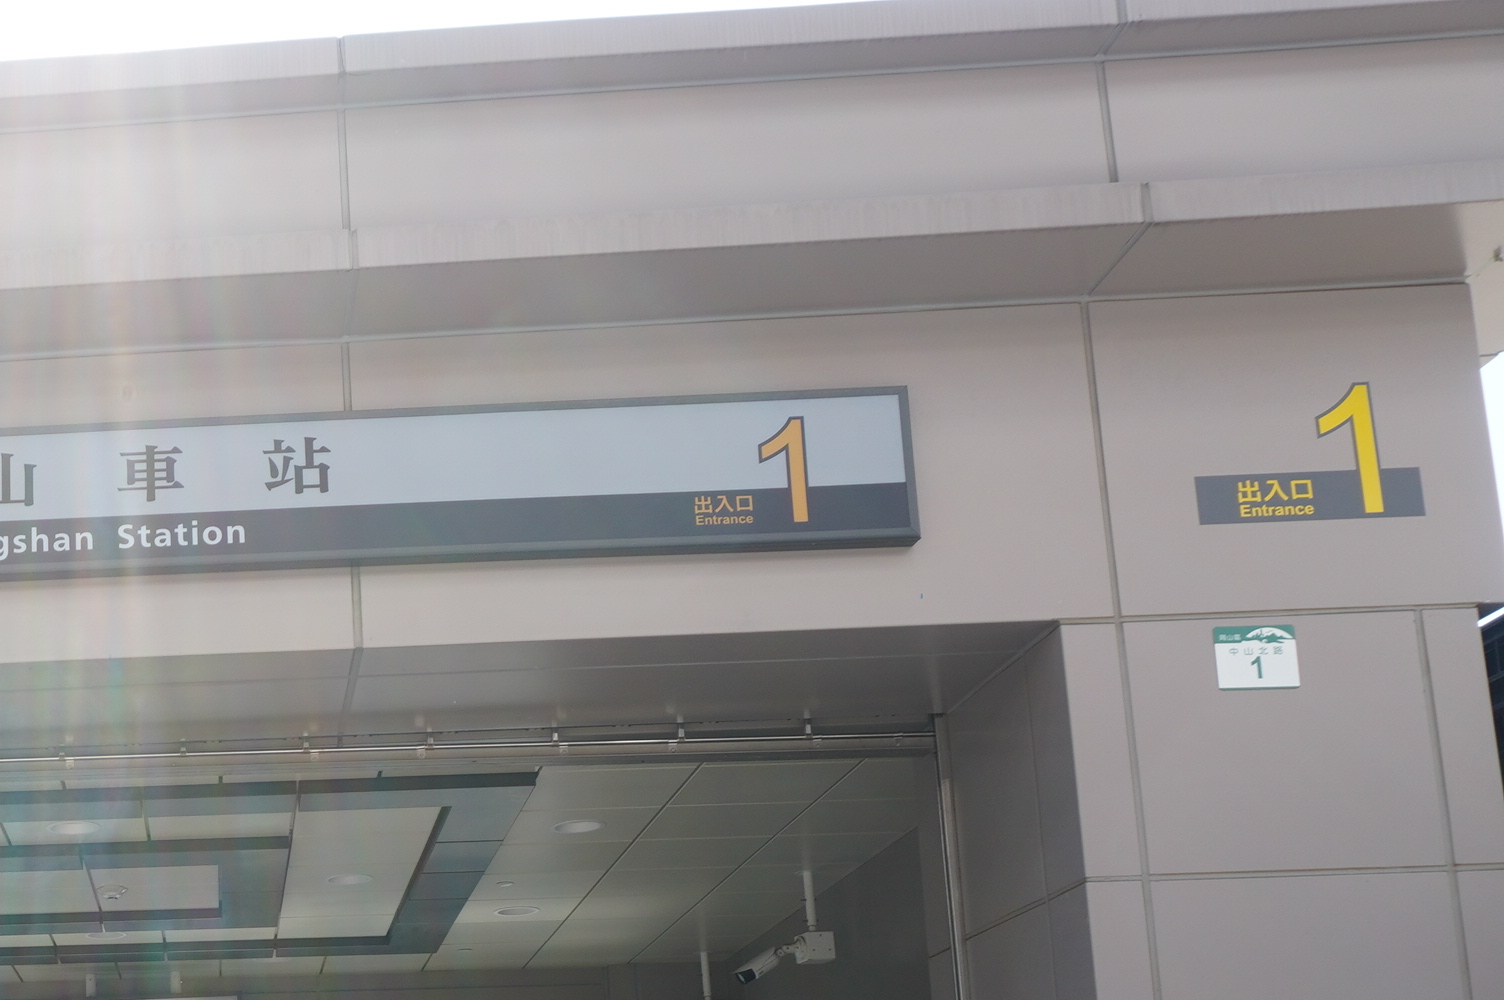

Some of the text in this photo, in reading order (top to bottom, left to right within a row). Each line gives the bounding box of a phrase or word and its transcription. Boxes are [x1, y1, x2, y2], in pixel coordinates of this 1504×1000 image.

[1315, 381, 1384, 514] 1
[758, 415, 809, 523] 1
[1237, 479, 1314, 503] 出入口
[694, 494, 754, 514] 出入口
[1240, 503, 1315, 518] Entrance
[695, 513, 754, 526] Entrance
[117, 519, 247, 550] Station
[1228, 645, 1284, 656] 中山北路
[1250, 656, 1263, 679] 1
